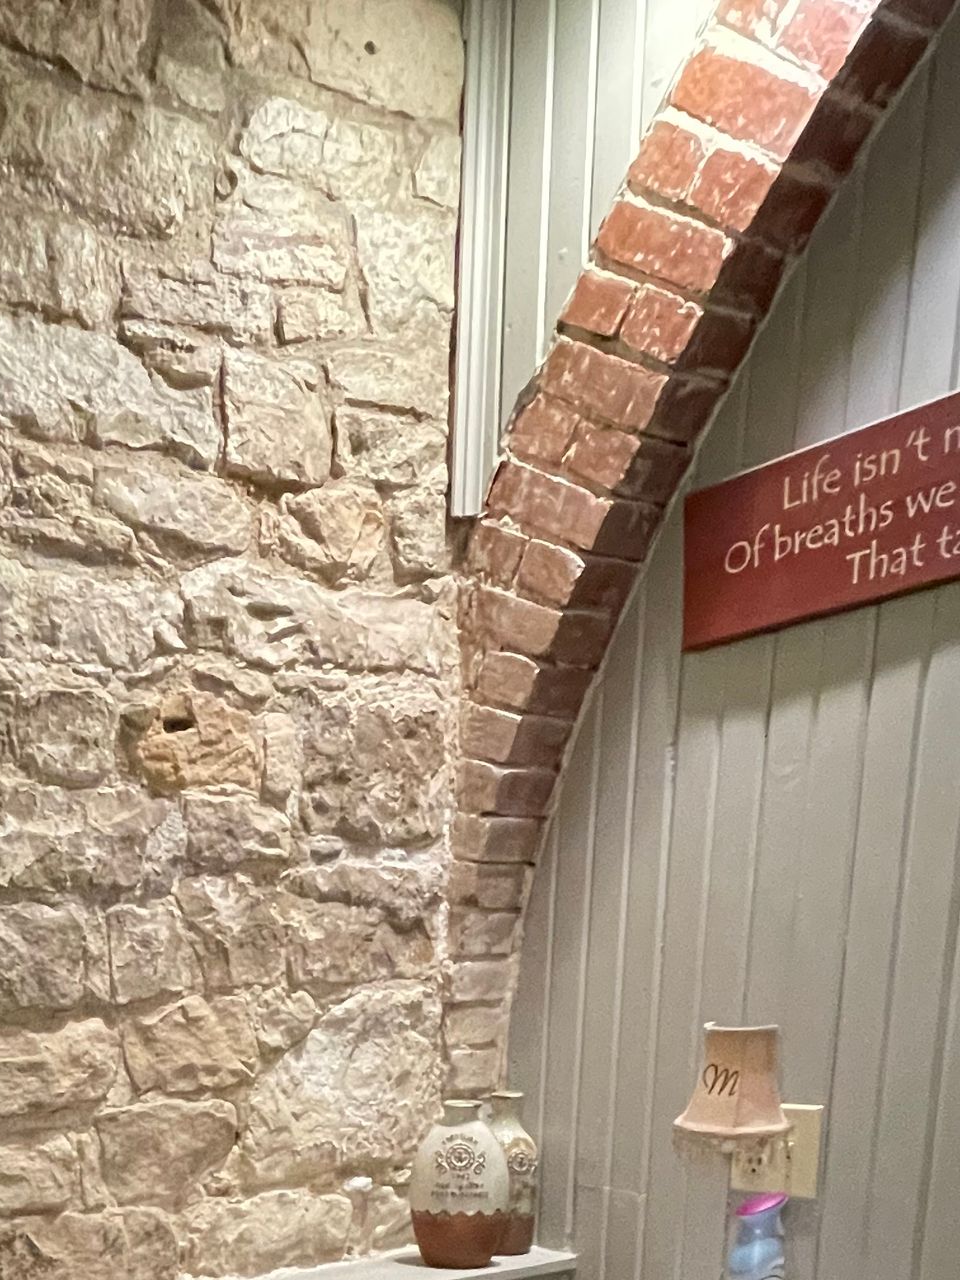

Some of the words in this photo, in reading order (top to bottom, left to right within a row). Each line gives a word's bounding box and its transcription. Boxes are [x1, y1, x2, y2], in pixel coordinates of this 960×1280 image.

[783, 455, 842, 510] Life
[853, 427, 931, 487] isn't
[724, 523, 770, 574] Of
[774, 493, 894, 561] breaths
[906, 480, 957, 518] we
[846, 533, 926, 584] That
